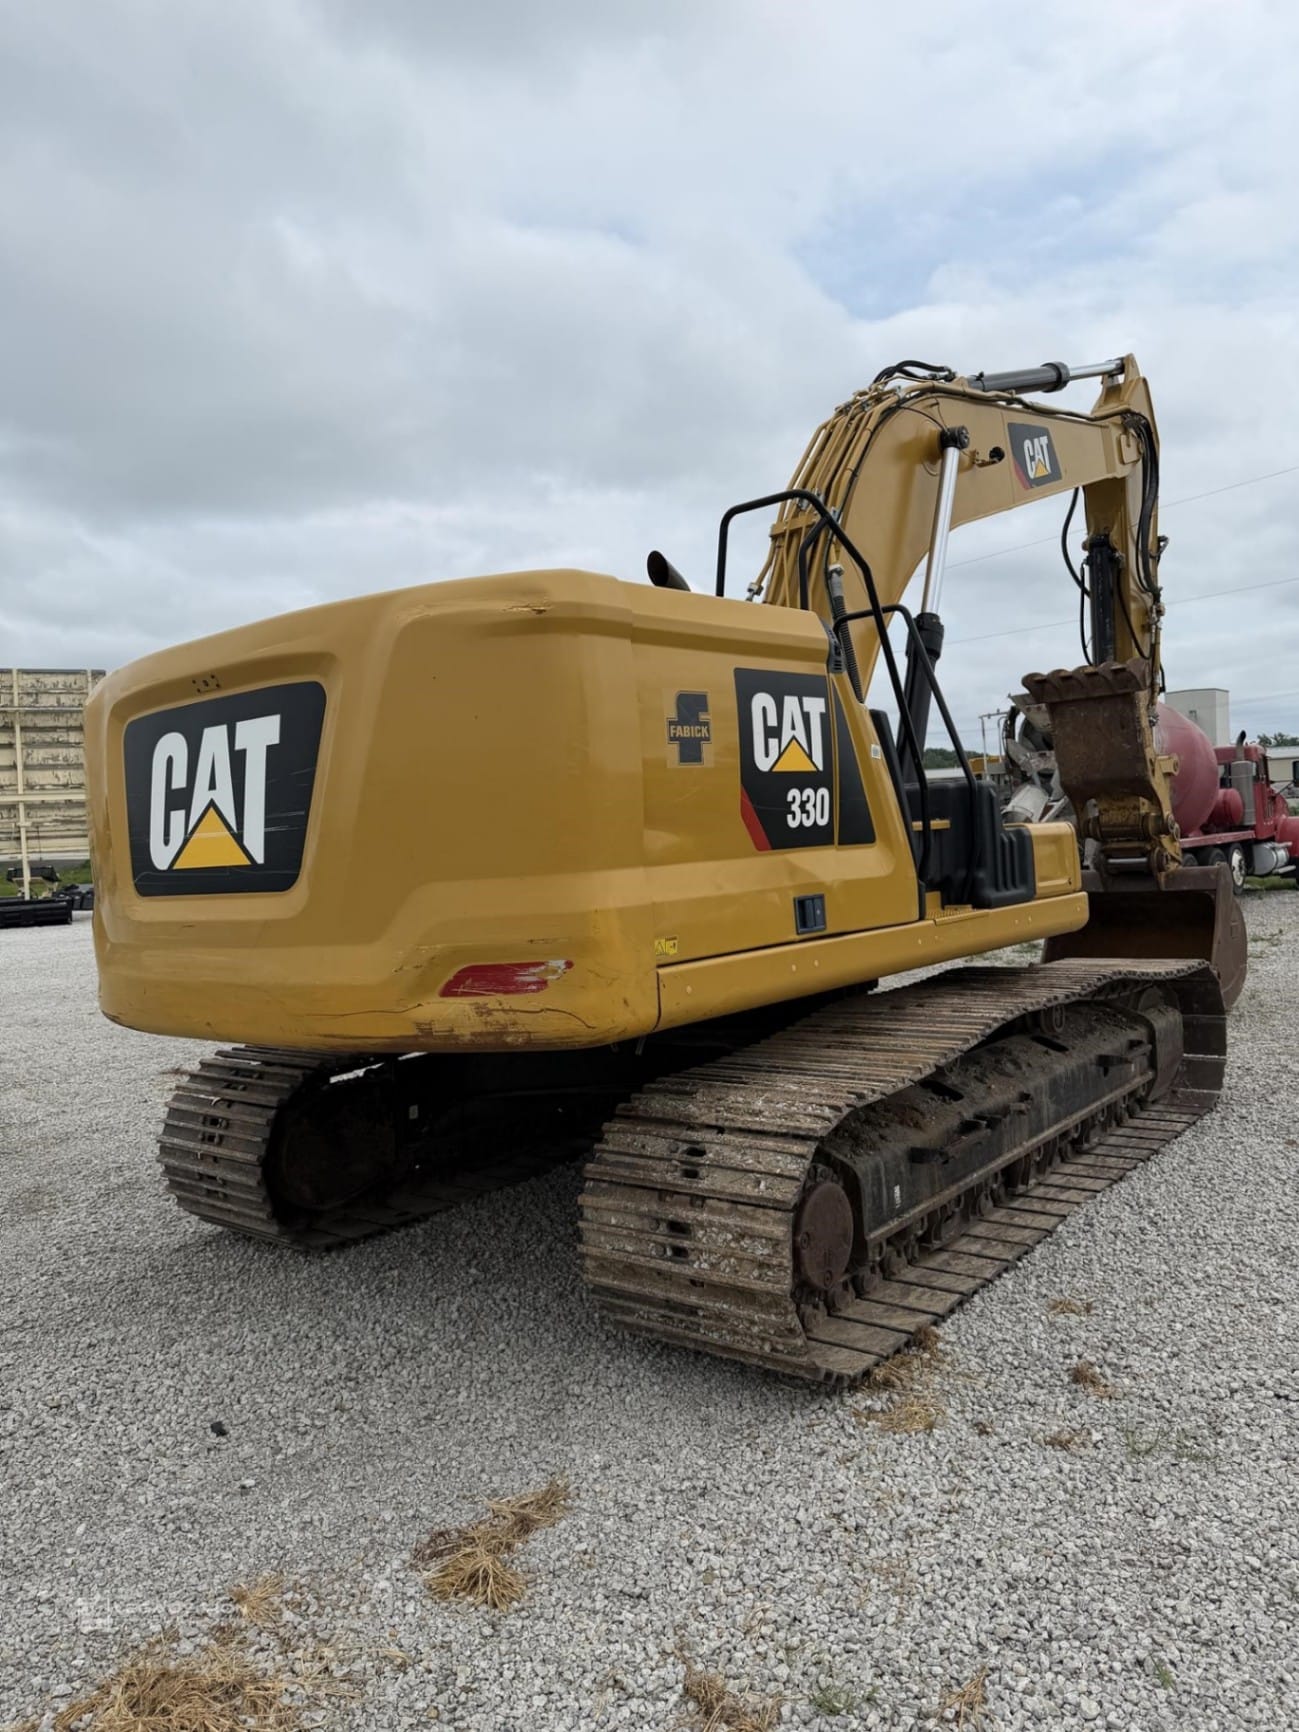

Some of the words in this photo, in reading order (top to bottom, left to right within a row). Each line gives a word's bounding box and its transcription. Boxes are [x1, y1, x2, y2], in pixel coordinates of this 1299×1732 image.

[1024, 436, 1051, 479] CAT
[670, 725, 709, 738] FABICK
[751, 692, 826, 772] CAT
[150, 714, 281, 871] CAT
[786, 788, 830, 829] 330
